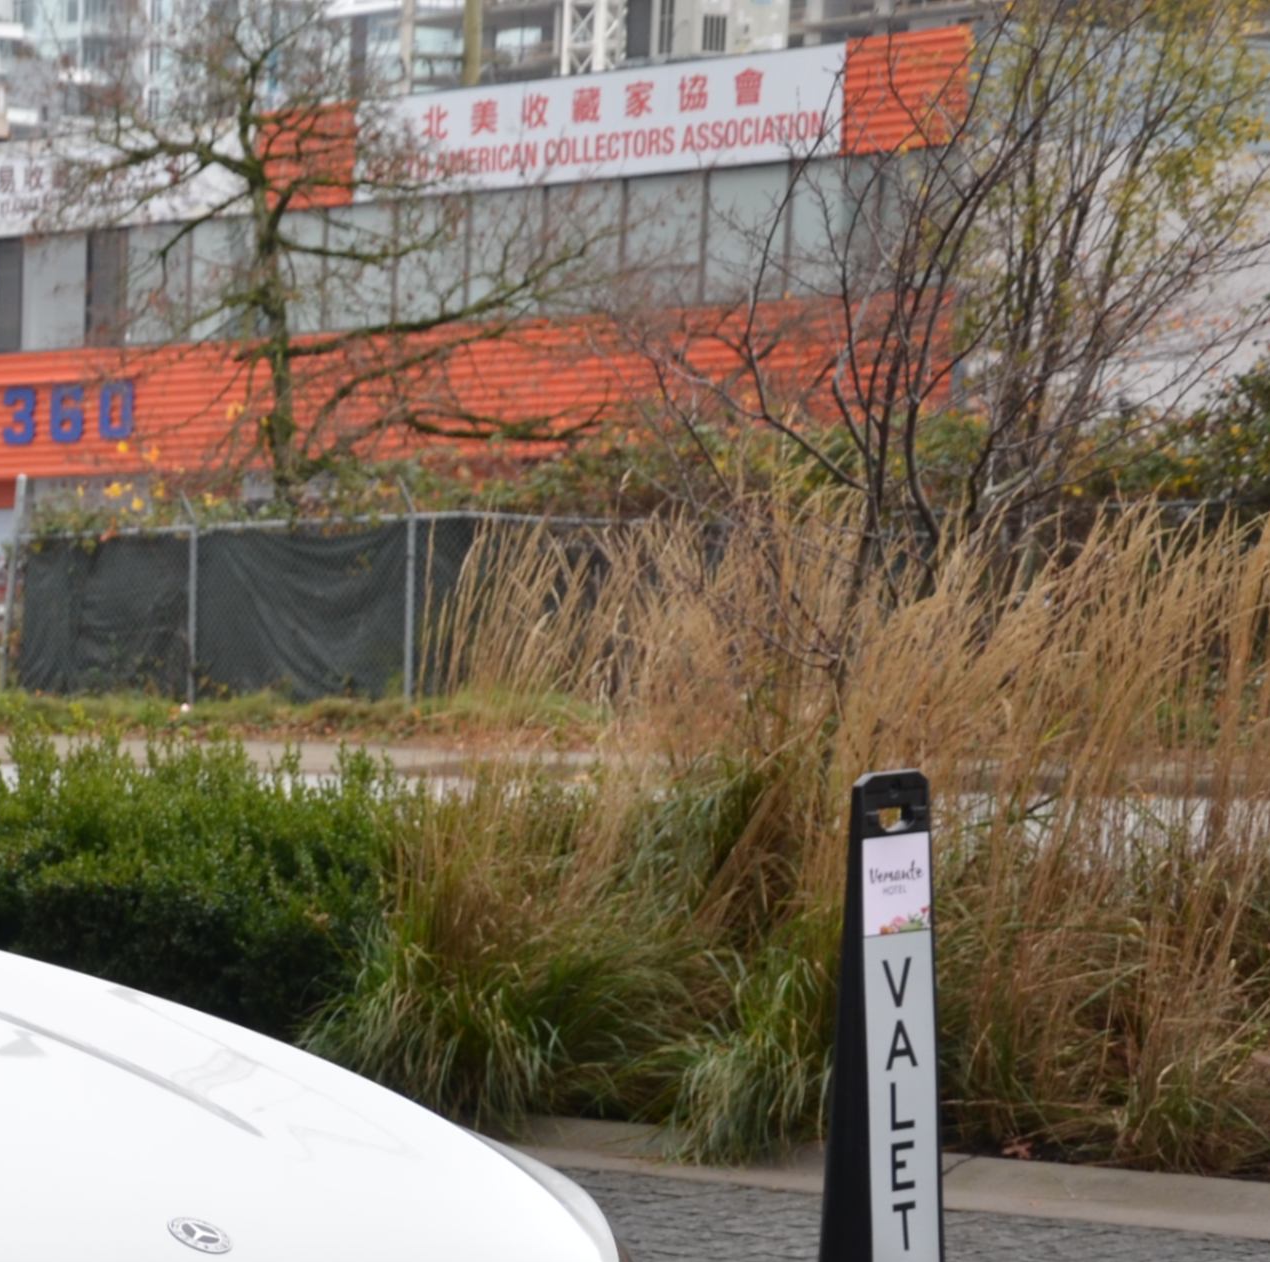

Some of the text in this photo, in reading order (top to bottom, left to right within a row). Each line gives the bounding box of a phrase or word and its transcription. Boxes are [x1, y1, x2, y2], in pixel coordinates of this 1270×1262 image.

[421, 67, 764, 142] 北美收藏家協會
[435, 141, 539, 177] AMERICAN
[544, 126, 676, 167] COLLECTORS
[681, 110, 826, 152] ASSOCIATION
[882, 956, 918, 1252] VALET
